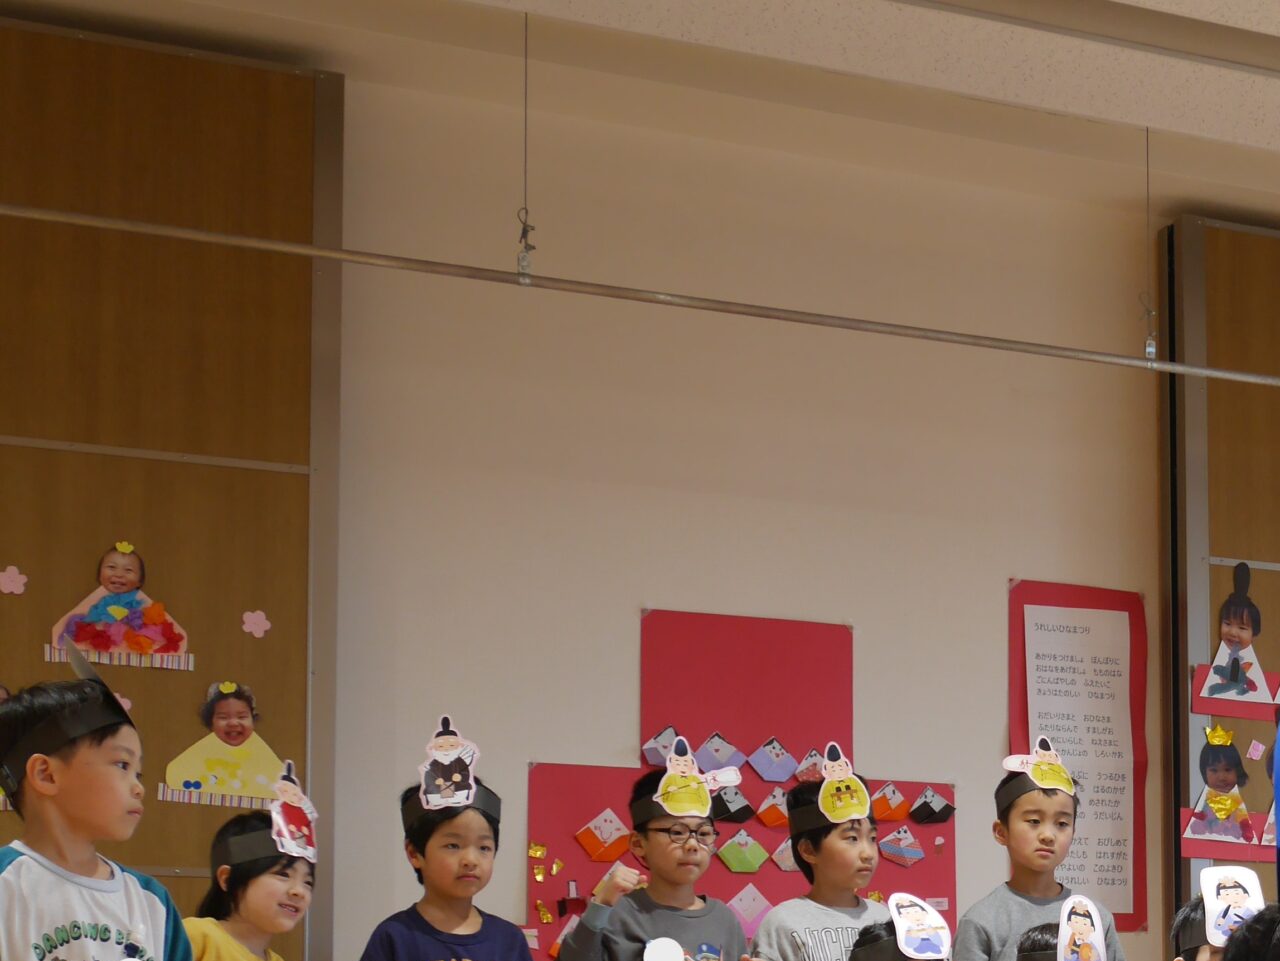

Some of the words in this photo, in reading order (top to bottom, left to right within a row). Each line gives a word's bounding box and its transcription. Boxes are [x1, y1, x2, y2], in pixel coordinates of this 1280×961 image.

[1034, 622, 1090, 634] うれしいひなまつり
[1034, 652, 1084, 663] あかりをつけましょ
[1035, 664, 1086, 675] おはなをあげましょ
[1093, 667, 1122, 677] もものはな
[1036, 675, 1077, 686] ごにんばやしの
[1036, 688, 1081, 697] きょうはたのしい
[1088, 690, 1116, 700] ひなまつり
[1038, 711, 1076, 721] おだいりさまと
[1038, 723, 1079, 733] ふたりならんで
[1086, 726, 1114, 735] すましがお
[1047, 736, 1084, 746] めにいらした
[1096, 877, 1128, 887] ひなまつり
[31, 919, 112, 961] DANCING
